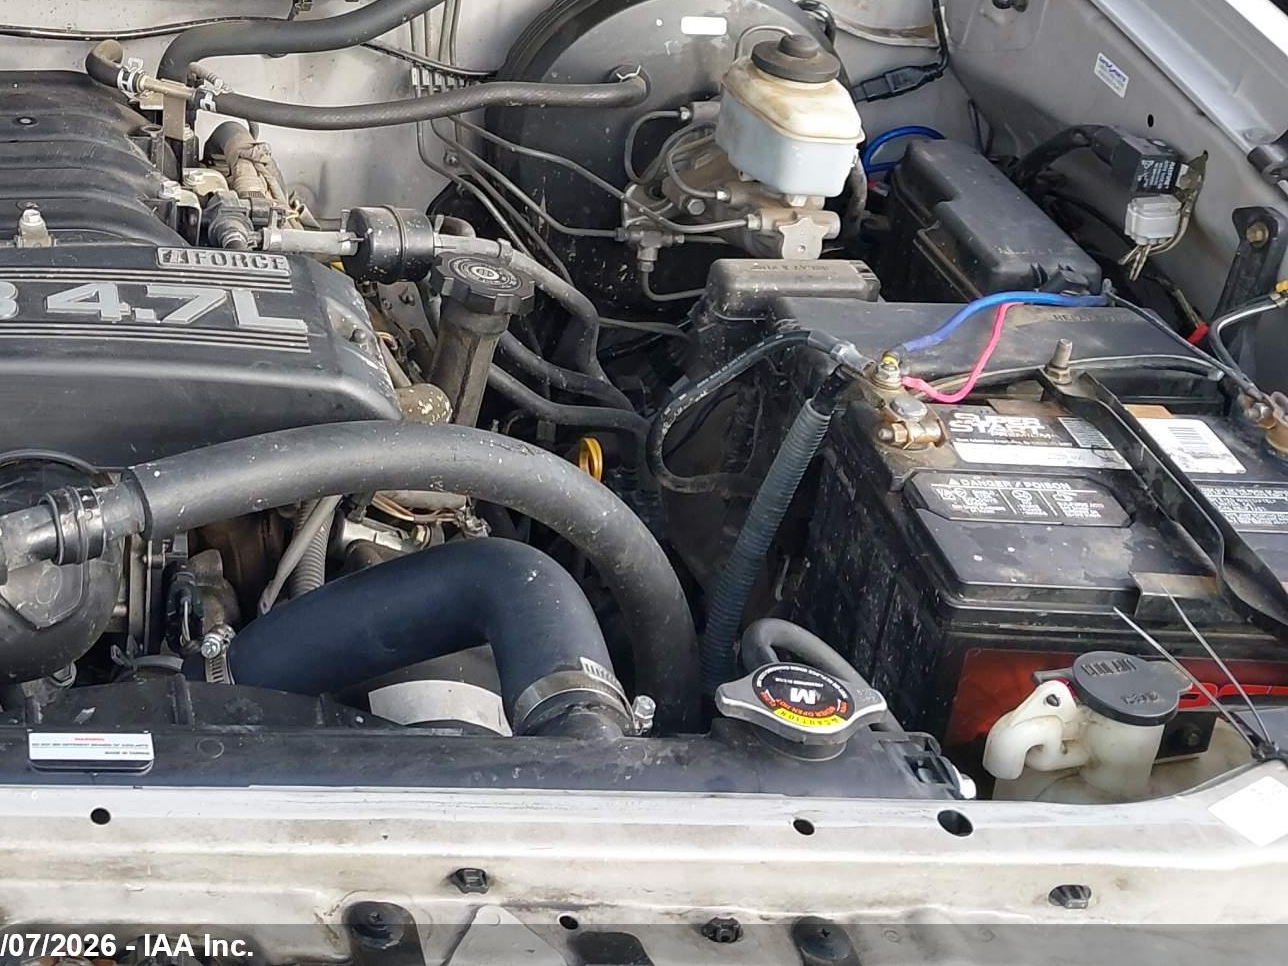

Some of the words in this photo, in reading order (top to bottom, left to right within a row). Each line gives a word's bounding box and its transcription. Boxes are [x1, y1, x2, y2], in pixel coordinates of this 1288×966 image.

[46, 281, 310, 334] 4.7L
[949, 419, 1045, 434] START
[953, 411, 1040, 427] SUPER
[960, 478, 1013, 488] DANGER
[1023, 480, 1072, 491] POISON
